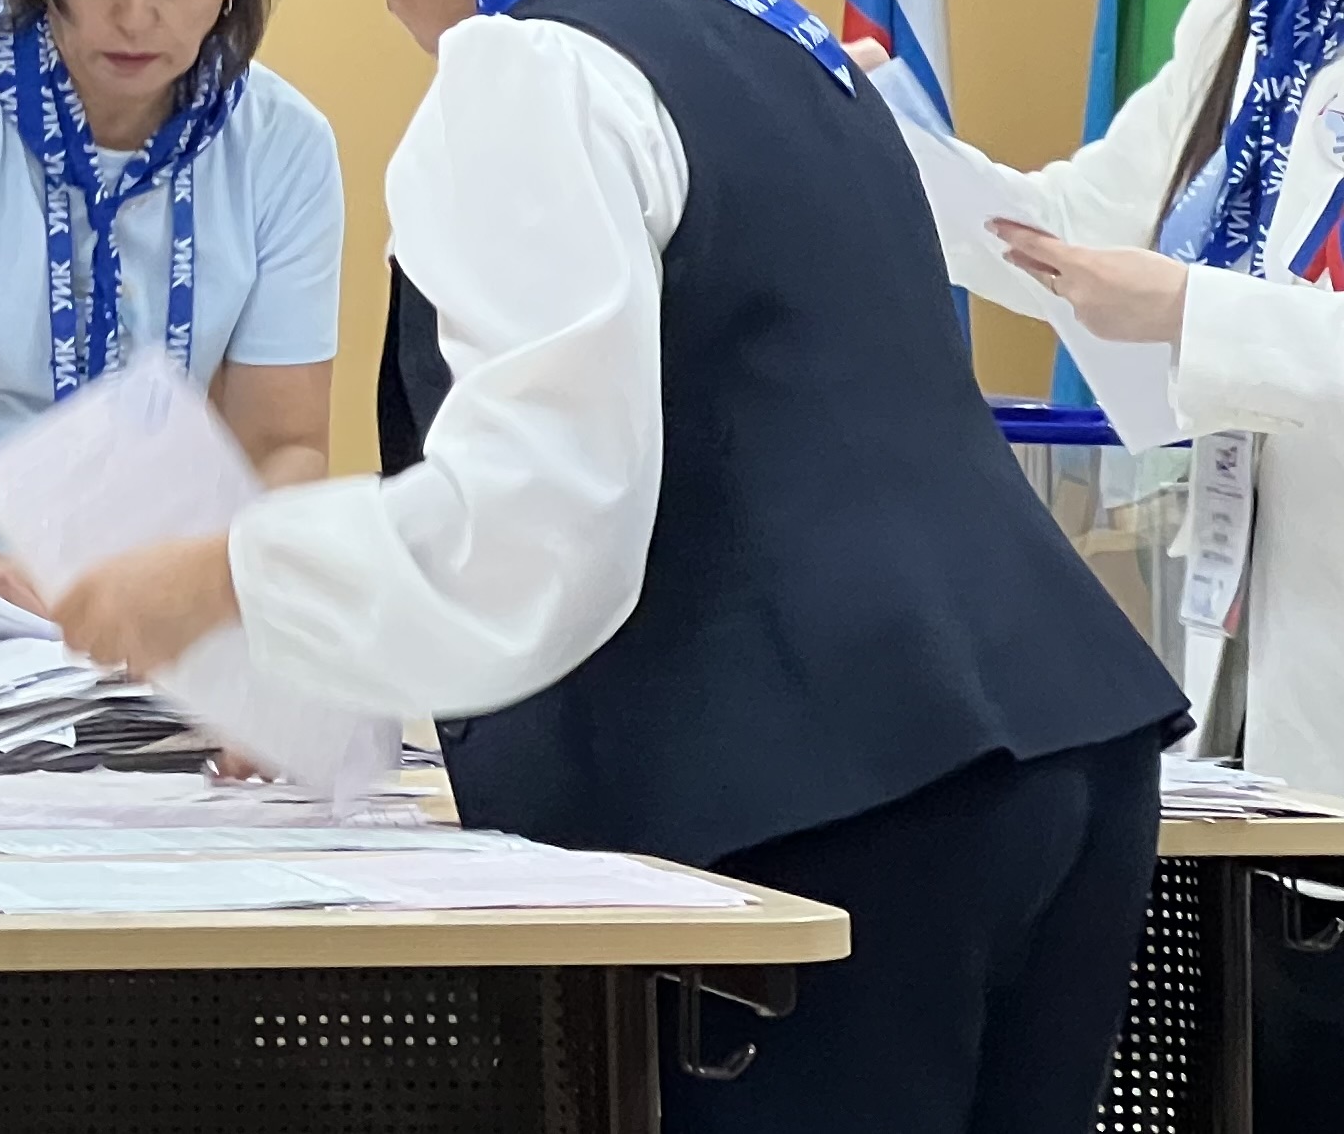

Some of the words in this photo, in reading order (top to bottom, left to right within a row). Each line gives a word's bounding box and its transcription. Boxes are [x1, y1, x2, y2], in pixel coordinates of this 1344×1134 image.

[41, 86, 63, 142] УИК
[1253, 75, 1292, 103] ИК
[1284, 59, 1312, 116] УИК
[50, 259, 73, 314] УИК
[172, 236, 193, 289] УИК
[54, 336, 78, 391] УИК
